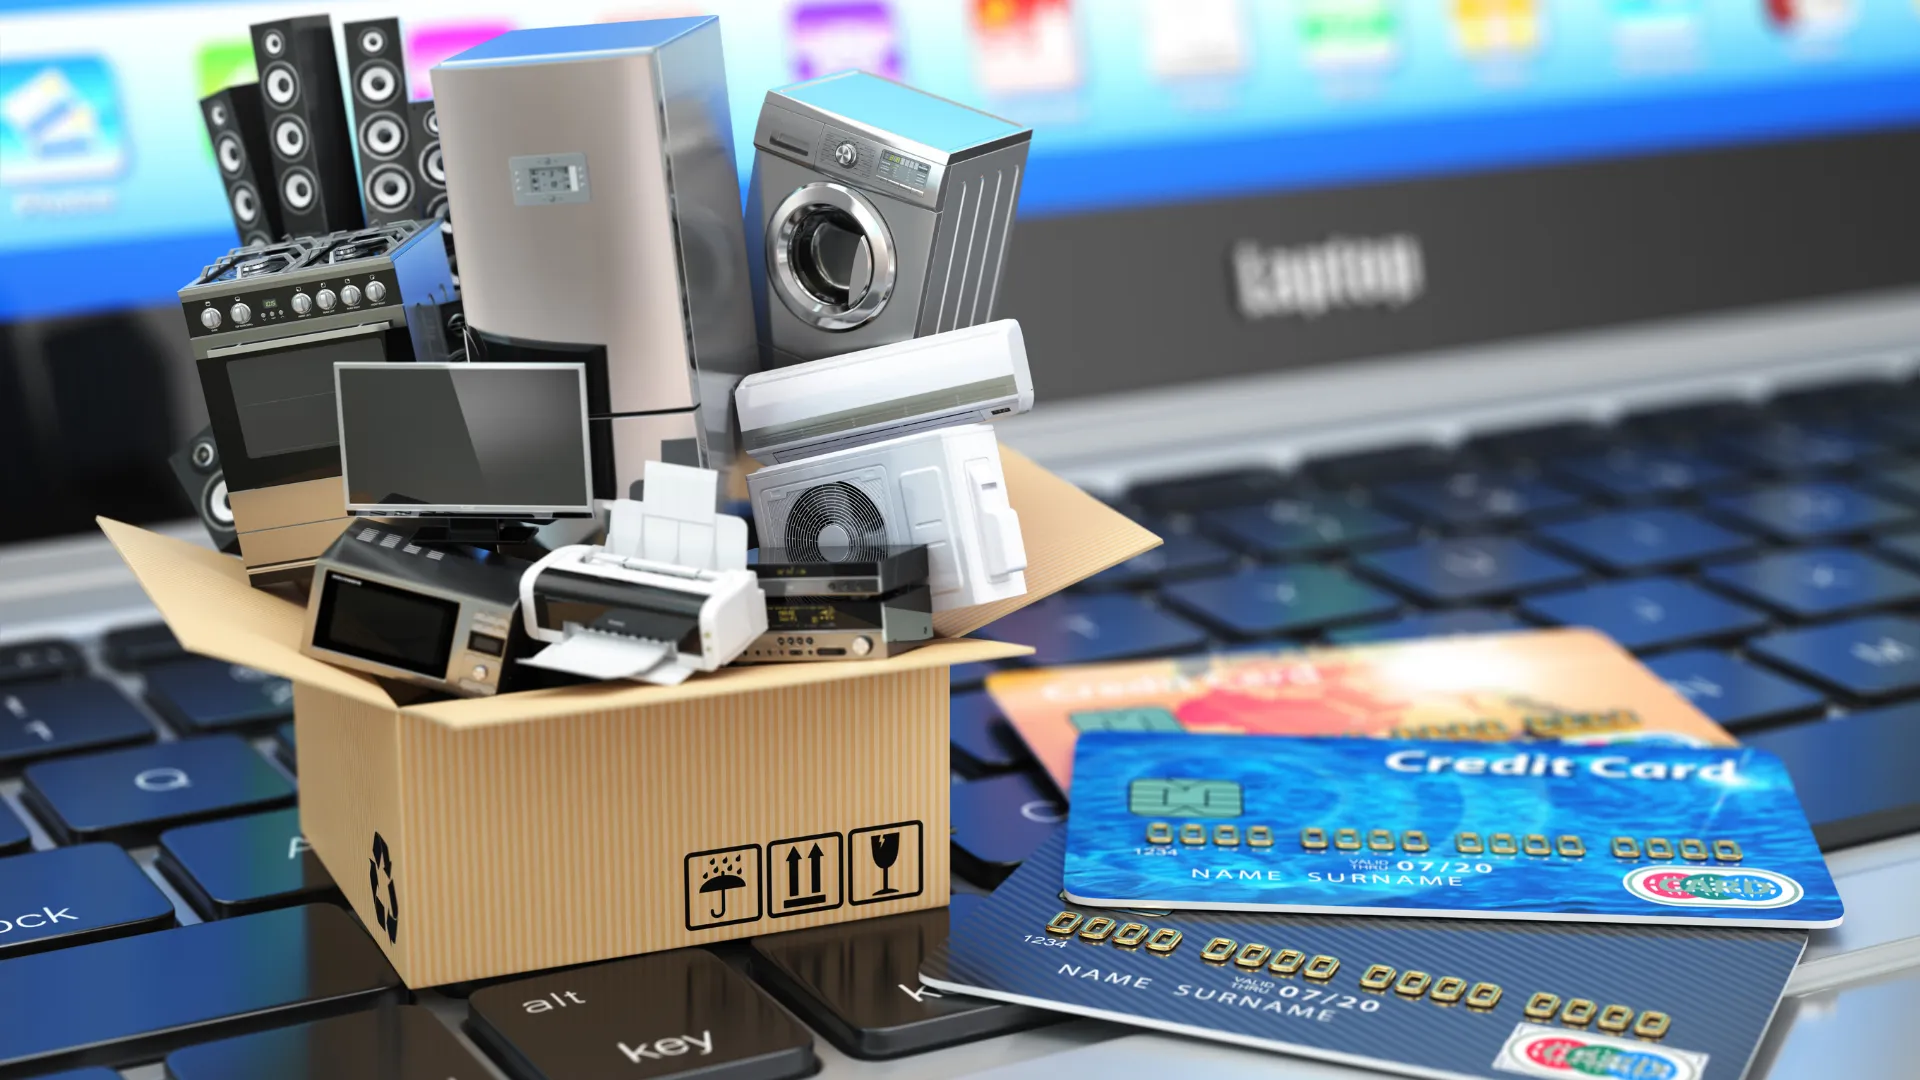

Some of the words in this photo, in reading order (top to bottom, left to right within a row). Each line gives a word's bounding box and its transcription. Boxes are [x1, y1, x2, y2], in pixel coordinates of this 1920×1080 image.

[1385, 749, 1574, 778] Credit
[1590, 756, 1743, 785] Card
[134, 767, 191, 791] Q
[1134, 847, 1179, 857] 1234
[1396, 861, 1493, 874] 07/20
[1192, 868, 1282, 881] NAME
[1308, 871, 1463, 887] SURNAME
[1658, 877, 1772, 895] CARD
[1023, 934, 1068, 949] 1234
[1231, 982, 1270, 994] THRU
[1233, 976, 1275, 989] VALID
[1058, 963, 1152, 990] NAME
[1173, 984, 1337, 1022] SURNAME
[1278, 984, 1380, 1013] 07/20
[522, 991, 586, 1014] alt
[617, 1029, 713, 1063] key
